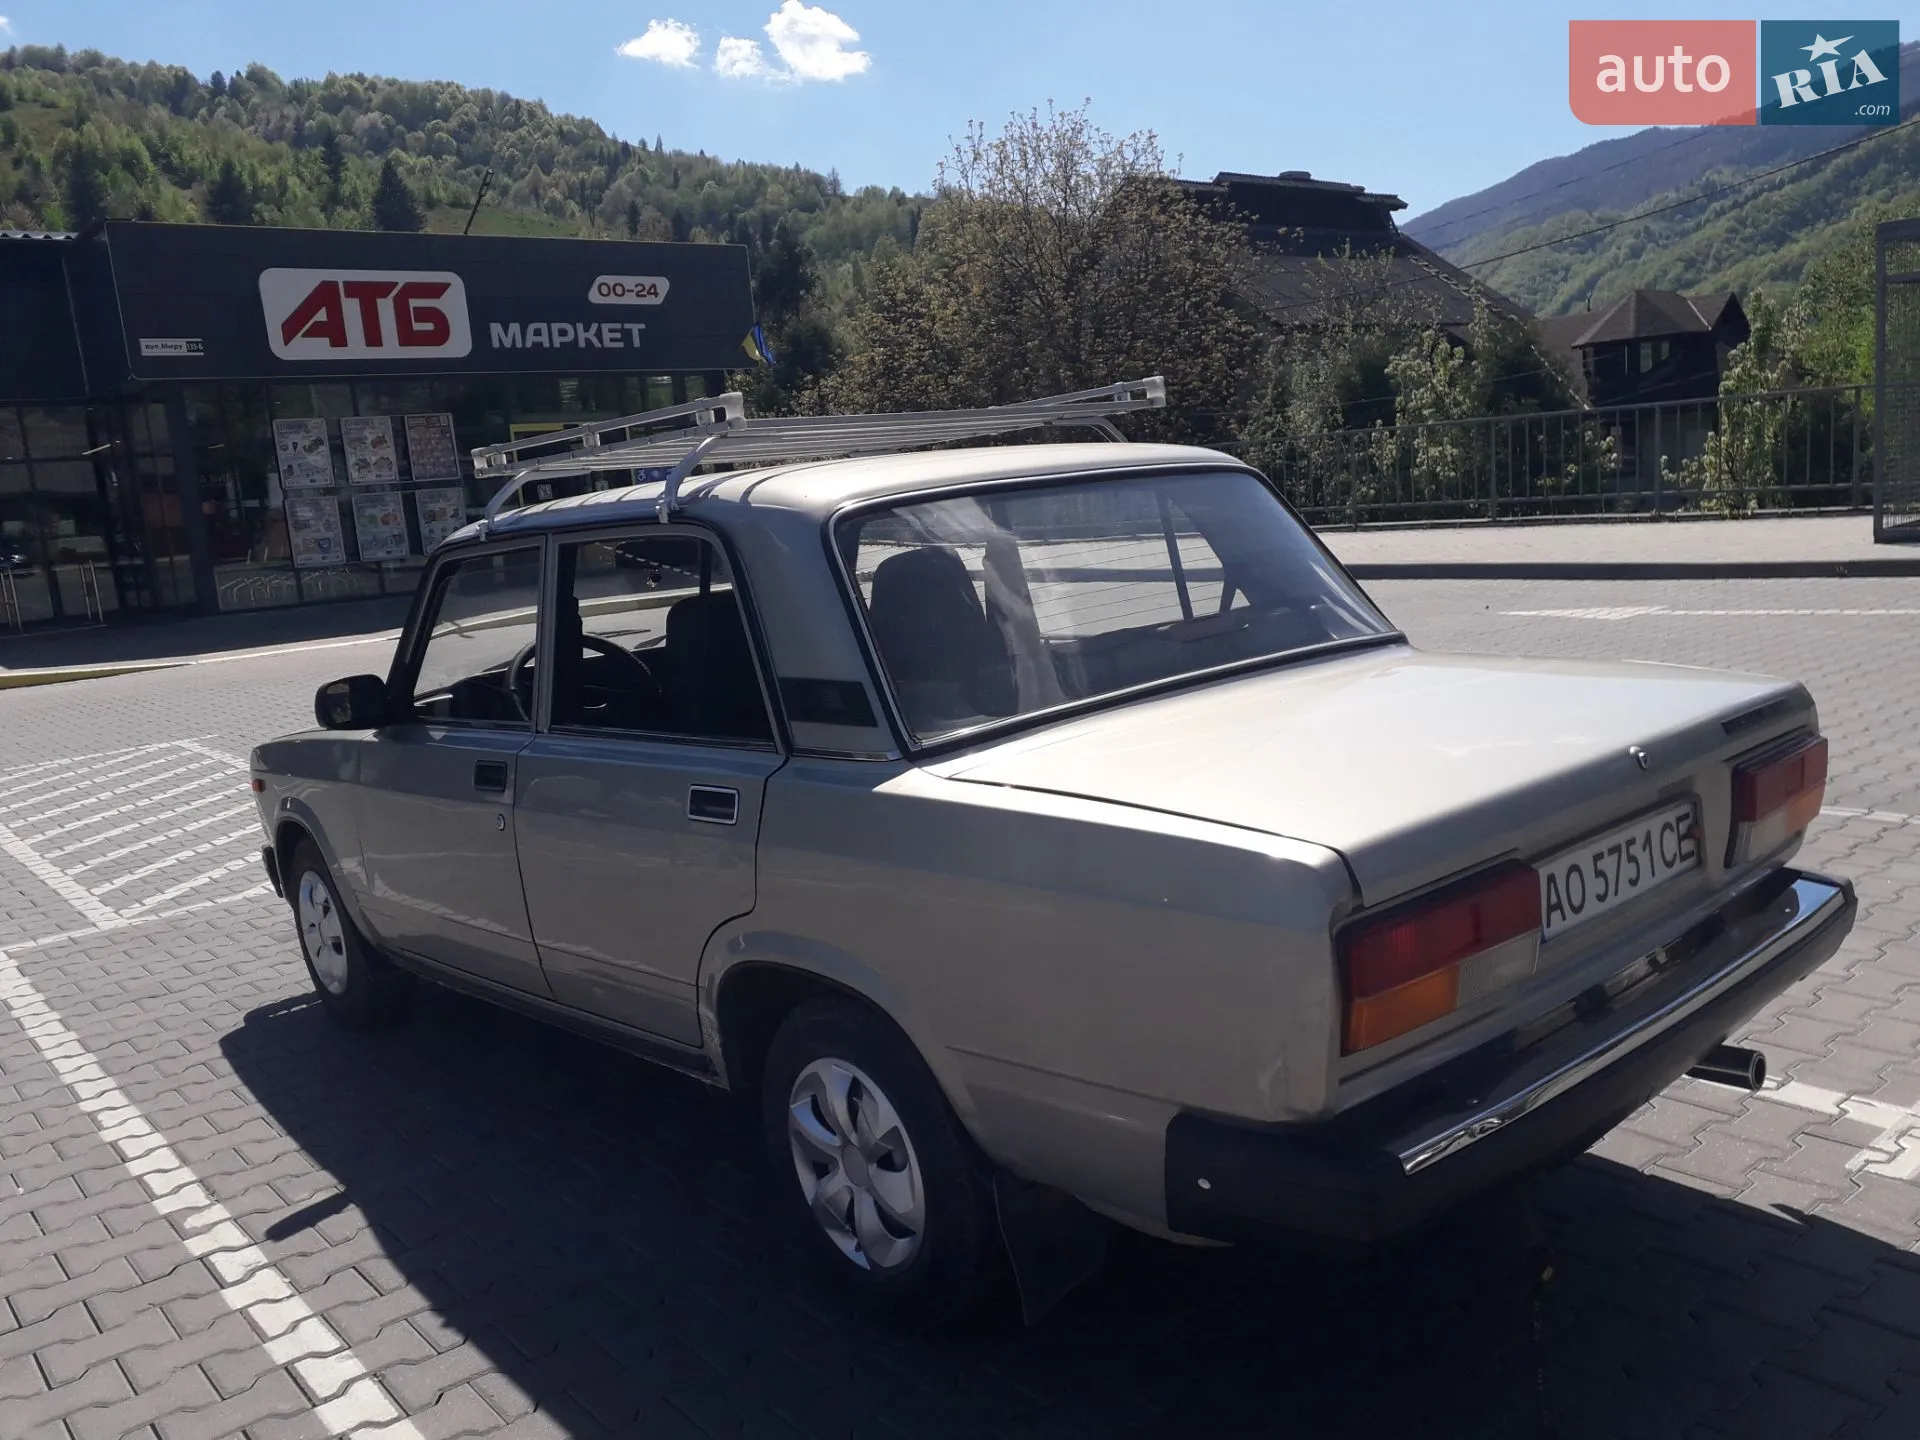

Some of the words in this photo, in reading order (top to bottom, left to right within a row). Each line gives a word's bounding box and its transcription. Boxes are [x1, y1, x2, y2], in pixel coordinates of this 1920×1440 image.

[597, 282, 659, 298] 00-24
[281, 280, 451, 347] АТБ
[489, 322, 646, 348] МАРКЕТ
[1546, 863, 1586, 928] AO
[1592, 828, 1656, 903] 5751
